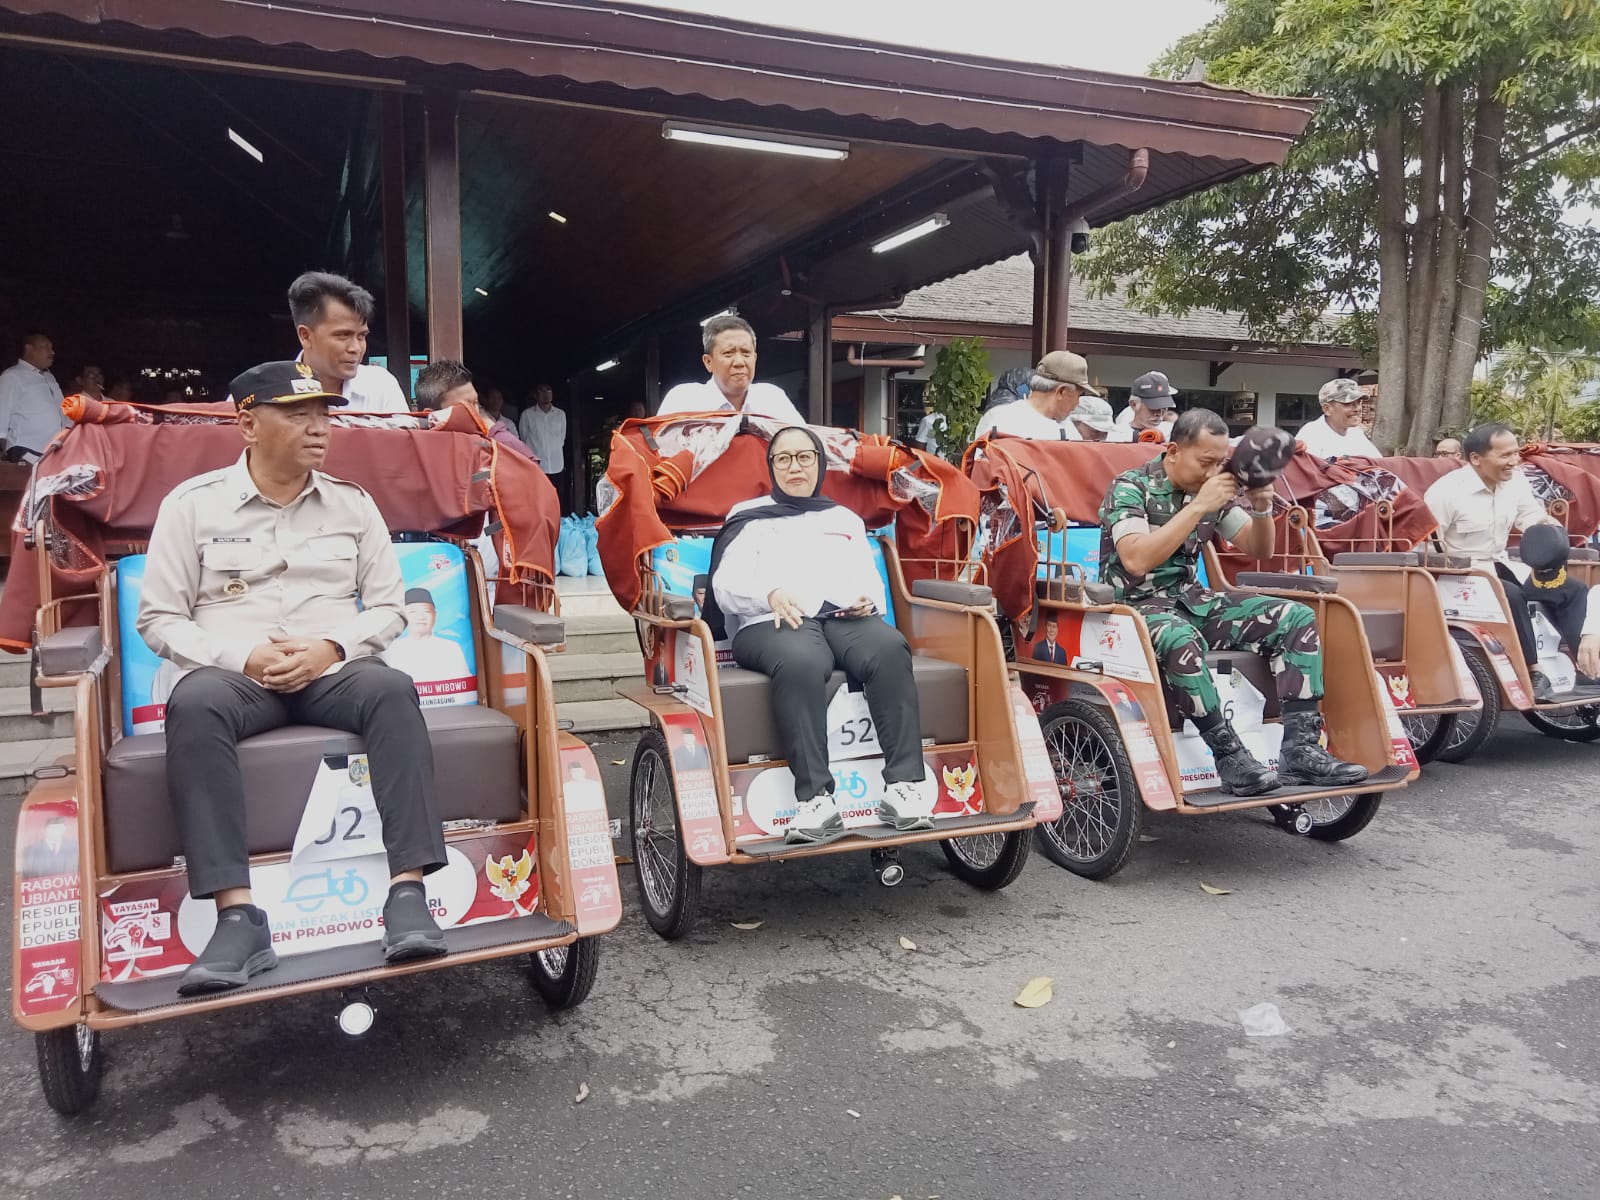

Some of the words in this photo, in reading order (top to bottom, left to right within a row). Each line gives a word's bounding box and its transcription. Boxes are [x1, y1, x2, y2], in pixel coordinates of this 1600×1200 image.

[415, 684, 433, 695] UNU
[435, 680, 467, 692] WIBOWO
[841, 717, 874, 746] 52
[21, 875, 80, 892] RABOW
[22, 902, 80, 920] RESIDE
[114, 901, 157, 913] YAYASAN
[23, 915, 80, 933] EPUBLI
[296, 918, 374, 940] PRABOWO
